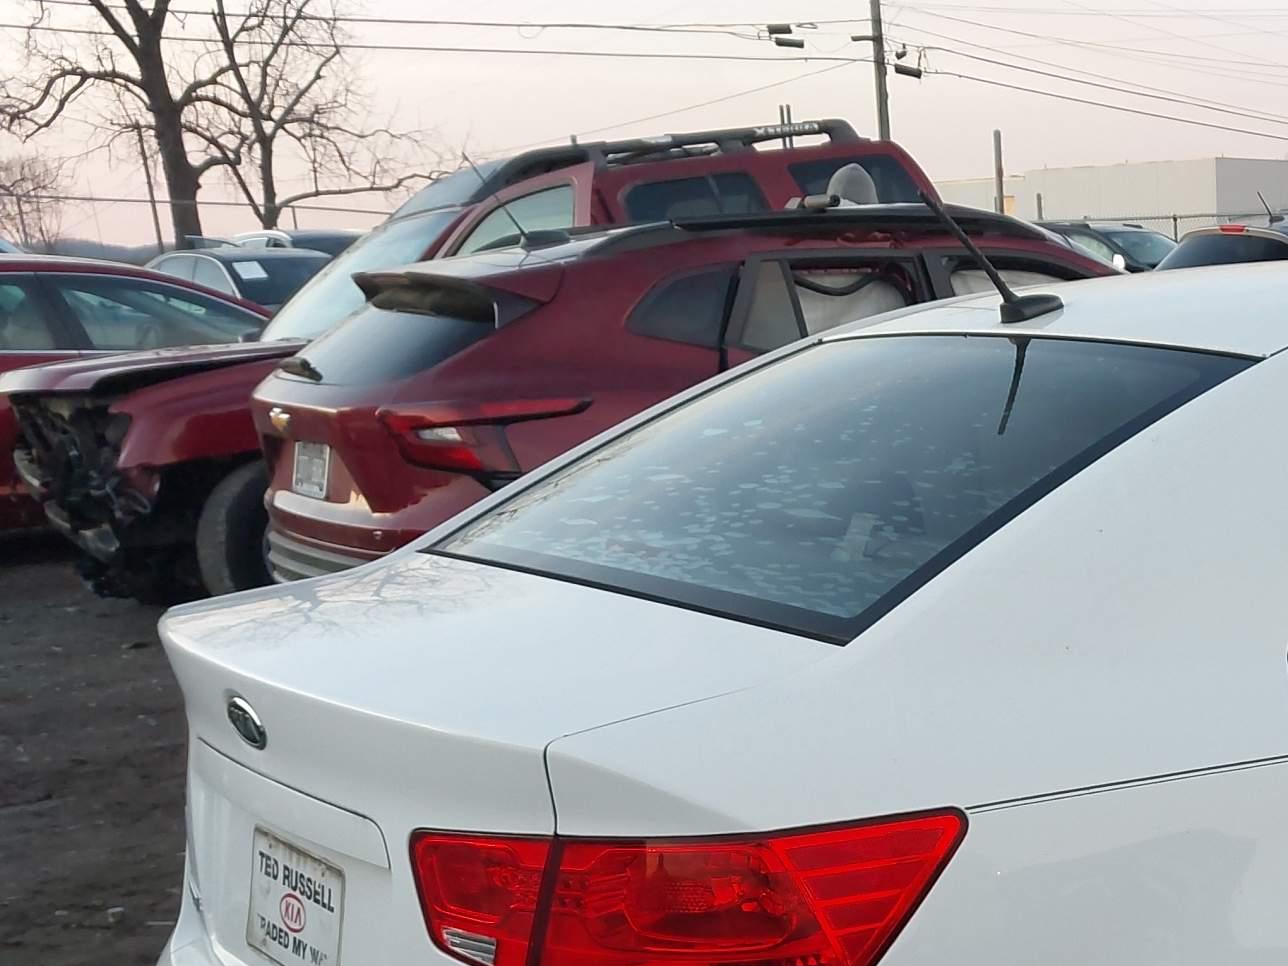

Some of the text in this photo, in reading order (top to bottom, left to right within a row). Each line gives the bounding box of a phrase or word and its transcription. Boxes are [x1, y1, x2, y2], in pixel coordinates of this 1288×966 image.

[258, 850, 335, 913] TED RUSSELL
[283, 899, 302, 927] KIA
[292, 936, 307, 960] MY
